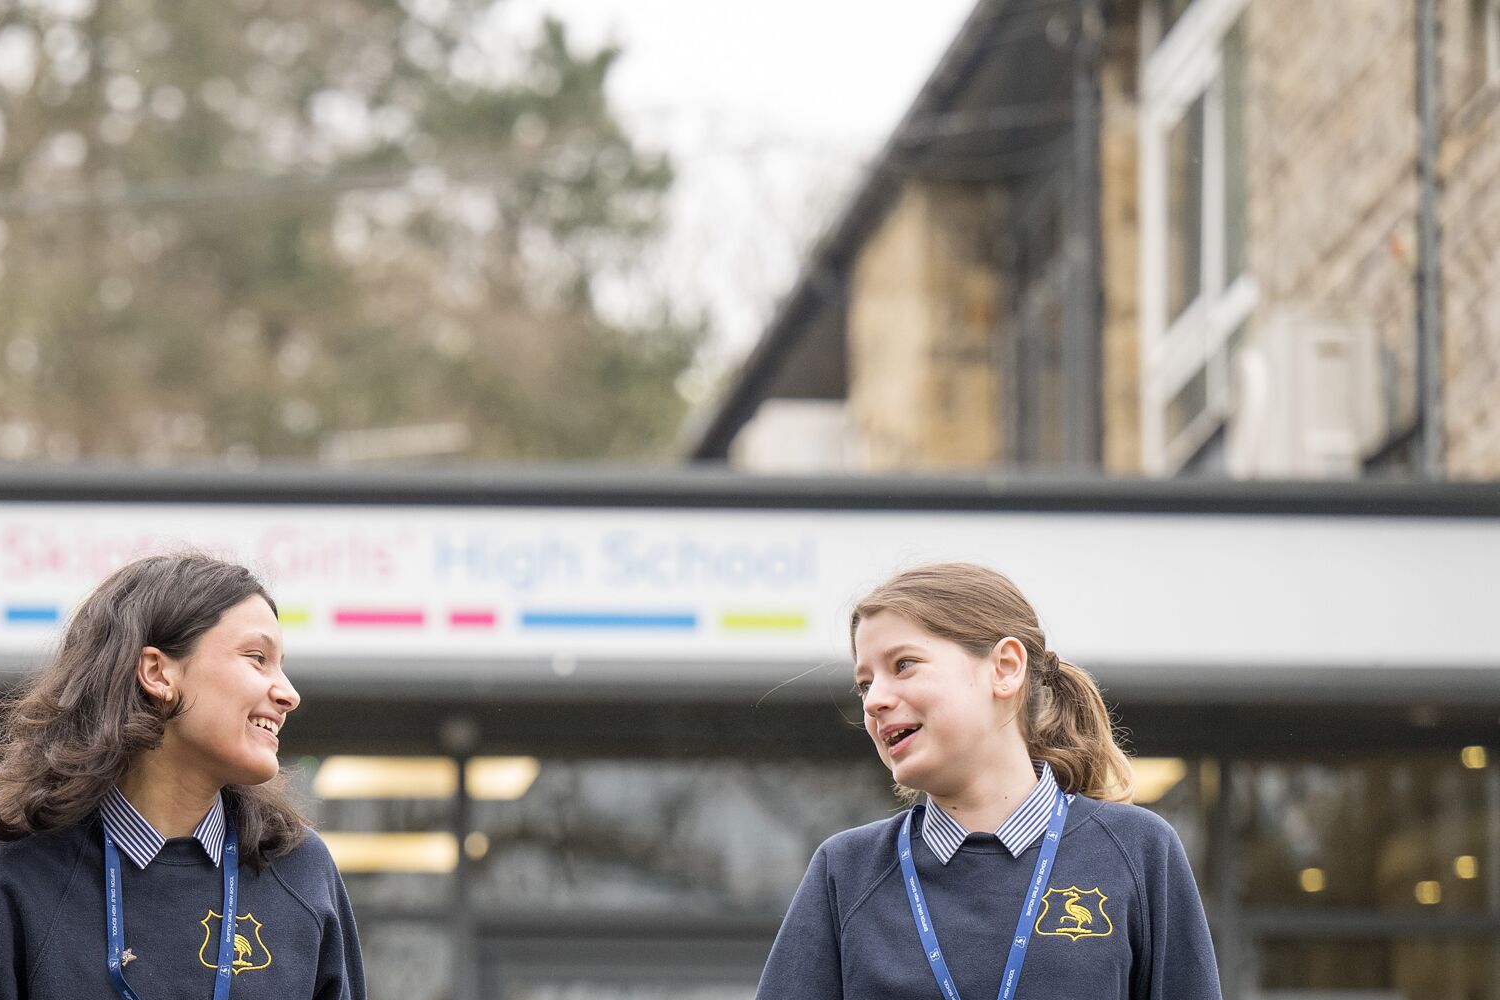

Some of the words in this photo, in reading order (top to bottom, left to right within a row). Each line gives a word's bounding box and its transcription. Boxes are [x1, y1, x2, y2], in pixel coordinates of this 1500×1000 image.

[255, 524, 419, 584] Girls'
[431, 526, 582, 593] High
[601, 528, 818, 585] School
[1039, 859, 1048, 876] SCHOOL
[1006, 969, 1016, 988] SCHOOL
